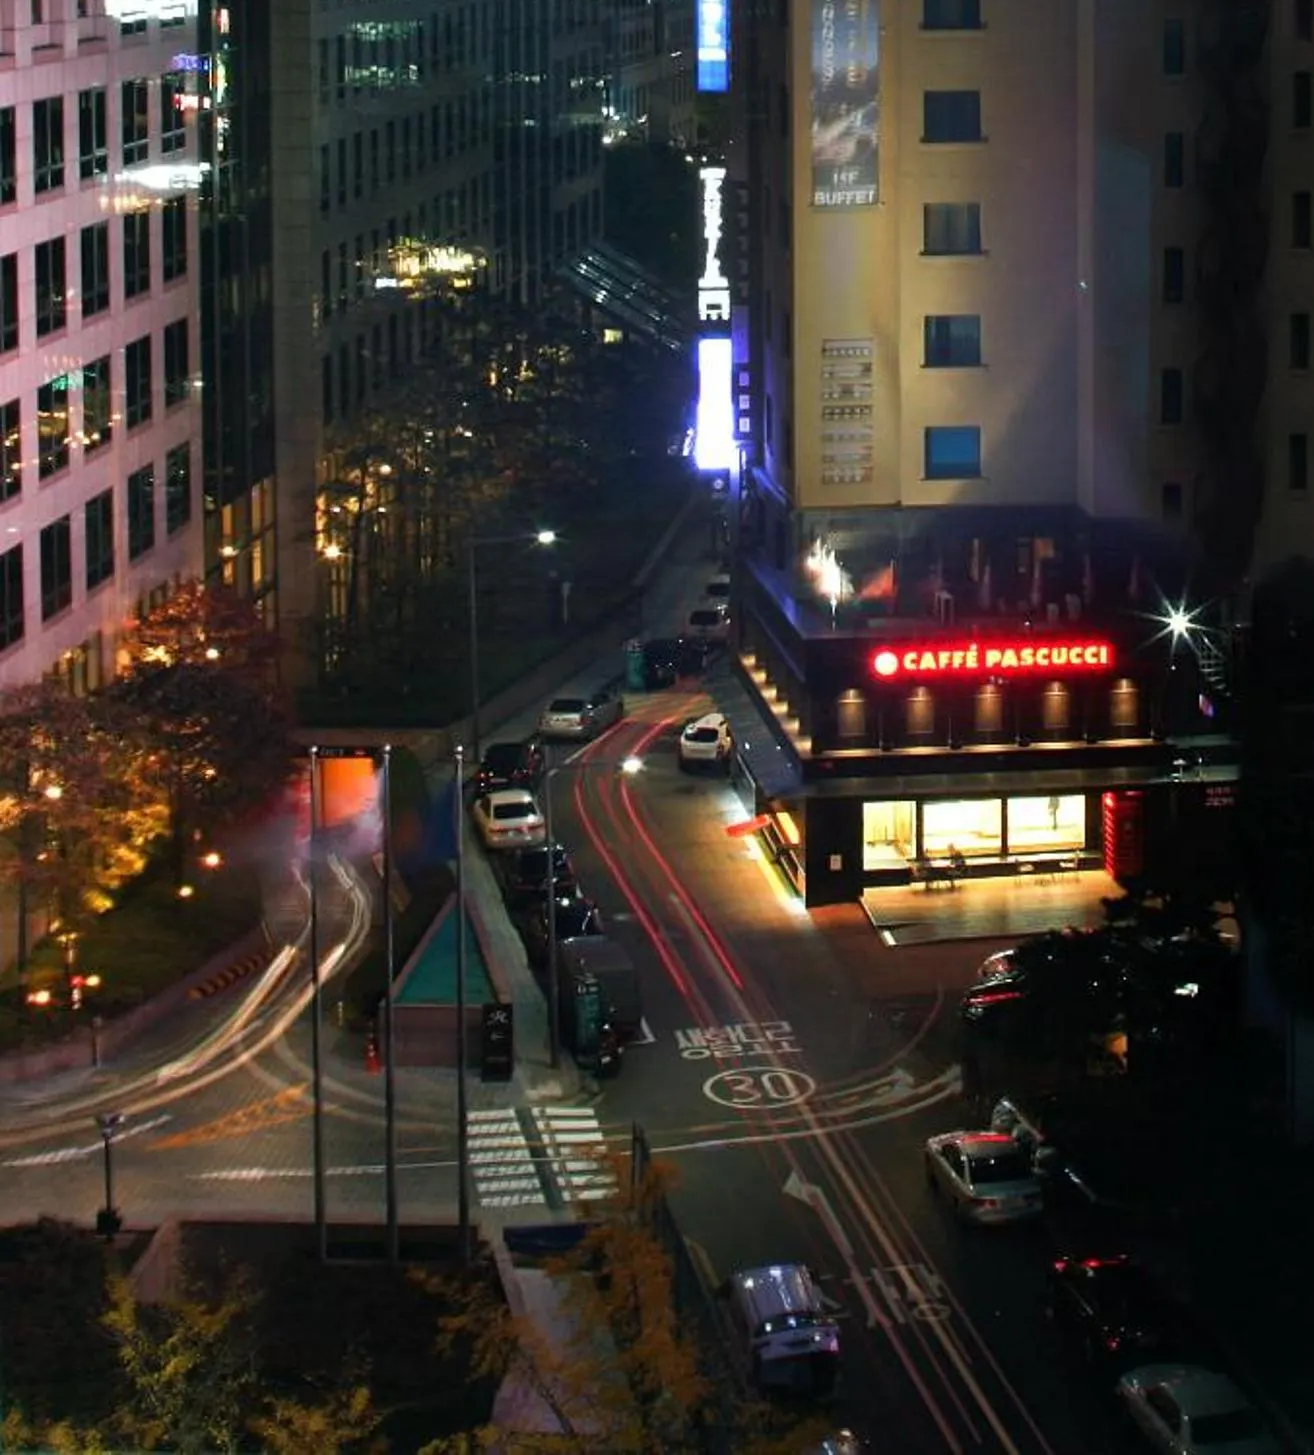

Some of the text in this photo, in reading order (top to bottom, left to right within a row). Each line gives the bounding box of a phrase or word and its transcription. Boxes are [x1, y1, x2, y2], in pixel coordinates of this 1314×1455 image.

[814, 190, 875, 206] BUFFET
[903, 643, 1108, 670] CAFFÉ PASCUCCI
[723, 1071, 800, 1103] 30
